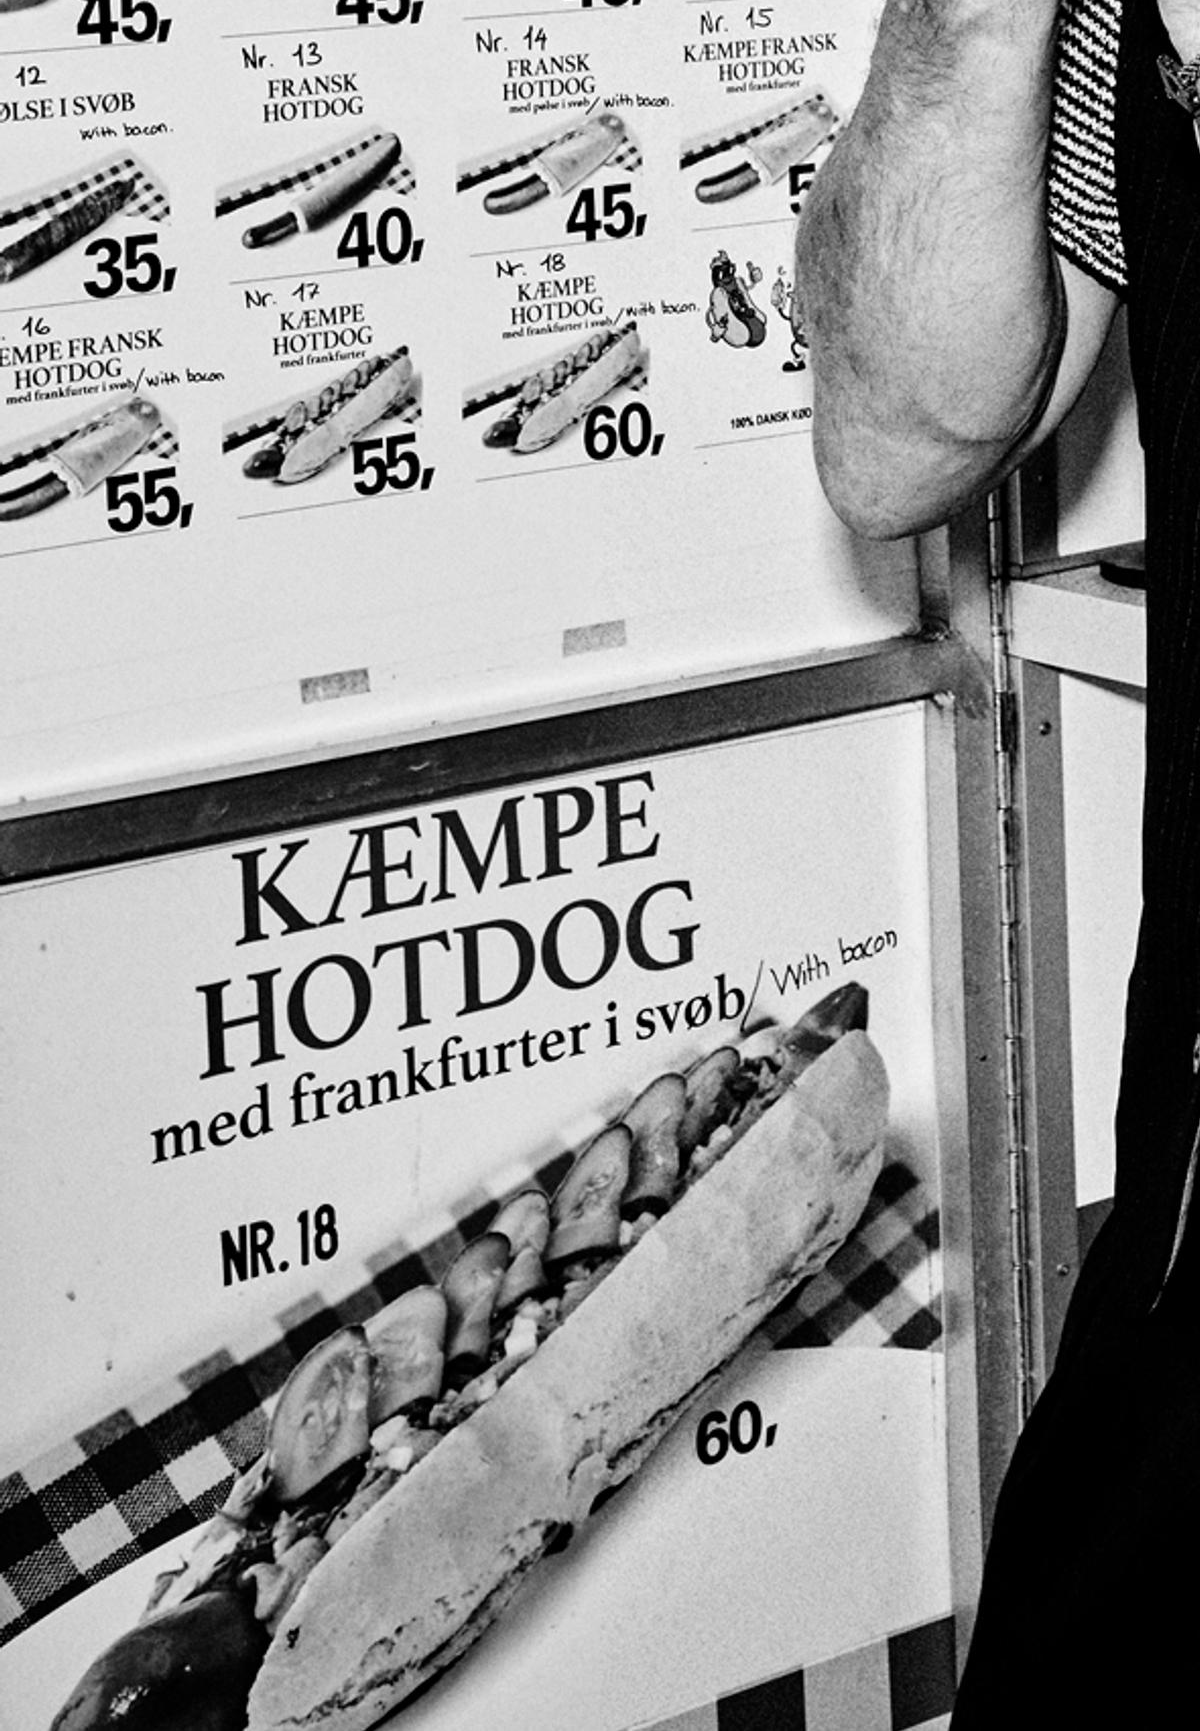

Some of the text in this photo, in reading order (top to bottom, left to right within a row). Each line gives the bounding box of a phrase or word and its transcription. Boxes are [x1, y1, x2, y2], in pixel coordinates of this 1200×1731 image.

[700, 10, 729, 36] Nr.
[475, 25, 549, 55] Nr. 14
[683, 32, 838, 63] KÆMPE FRANSK
[241, 41, 323, 72] Nr. 13
[506, 53, 591, 79] FRANSK
[718, 57, 805, 82] HOTDOG
[15, 65, 48, 88] 12
[267, 73, 358, 99] FRANSK
[502, 75, 596, 102] HOTDOG
[60, 97, 67, 118] I
[72, 91, 136, 117] SVØB
[263, 96, 364, 124] HOTDOG
[244, 288, 277, 310] Nr.
[517, 275, 596, 302] KÆMPE
[279, 304, 365, 332] KÆMPE
[511, 297, 603, 326] HOTDOG
[68, 328, 164, 358] FRANSK
[272, 326, 373, 357] HOTDOG
[14, 358, 123, 390] HOTDOG
[232, 771, 661, 947] KÆMPE
[838, 927, 897, 967] bacon
[196, 879, 700, 1079] HOTDOG
[151, 1084, 272, 1164] med
[288, 1019, 592, 1127] frankfurter
[605, 1006, 619, 1047] i
